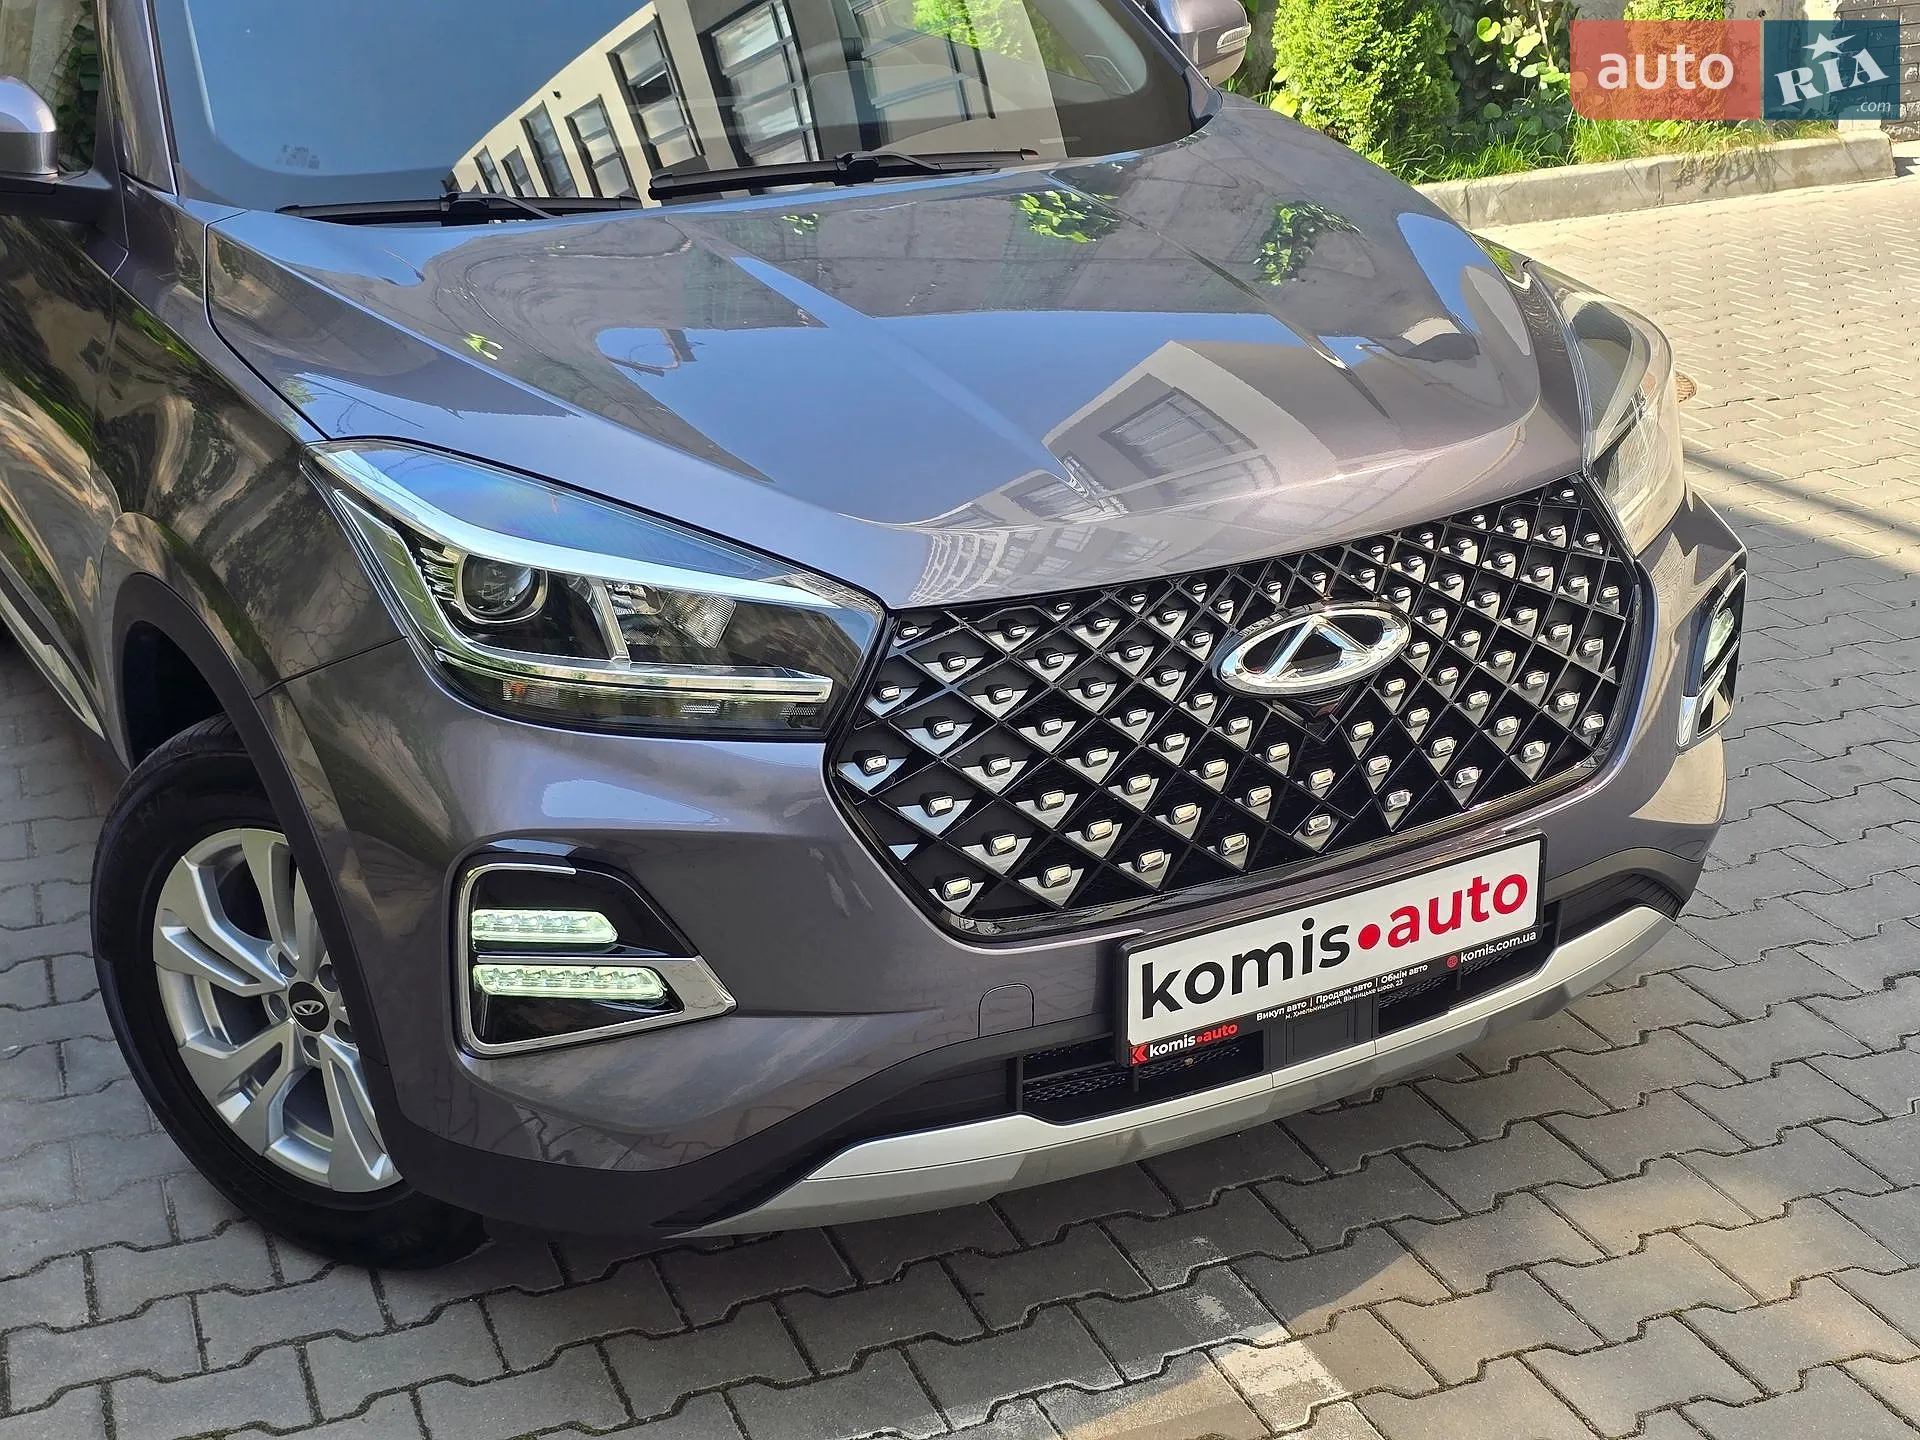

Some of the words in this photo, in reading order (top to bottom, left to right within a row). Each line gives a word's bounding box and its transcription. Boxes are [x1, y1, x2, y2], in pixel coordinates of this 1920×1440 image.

[1460, 931, 1537, 963] komis.com.ua
[1256, 1007, 1285, 1021] Викуп
[1286, 1001, 1307, 1012] авто
[1316, 988, 1352, 1004] Продаж
[1353, 981, 1373, 993] авто
[1381, 970, 1407, 984] Обмін
[1408, 964, 1428, 975] авто
